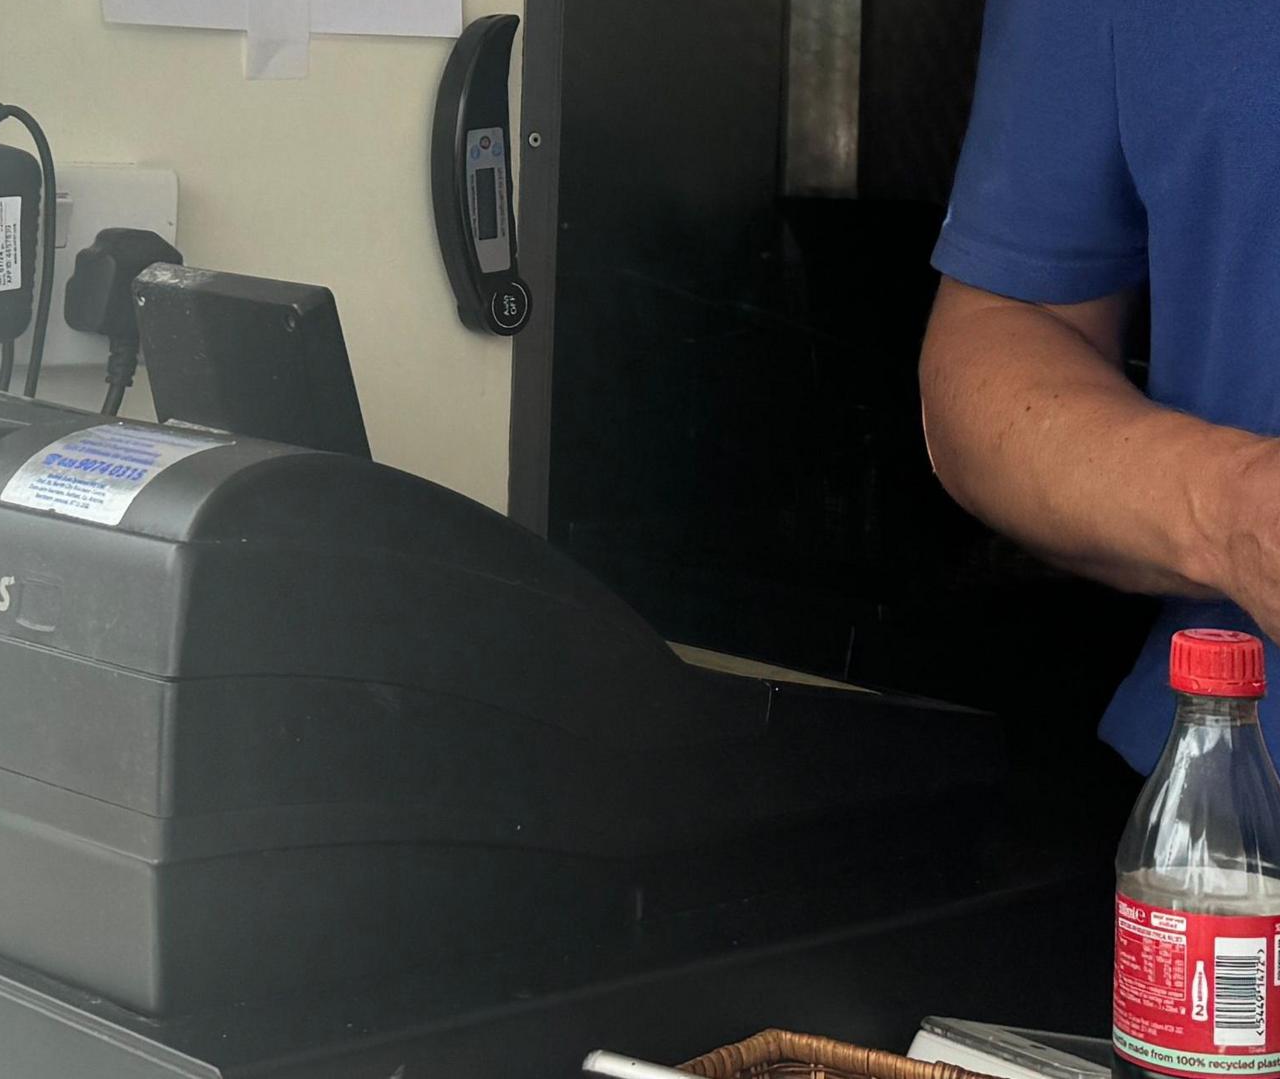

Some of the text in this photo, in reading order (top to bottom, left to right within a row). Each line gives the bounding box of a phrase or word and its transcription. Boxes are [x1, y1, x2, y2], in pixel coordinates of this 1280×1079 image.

[1195, 1004, 1205, 1017] 2
[1151, 1049, 1173, 1063] from
[1177, 1056, 1207, 1068] 100%
[1208, 1057, 1255, 1071] recycled
